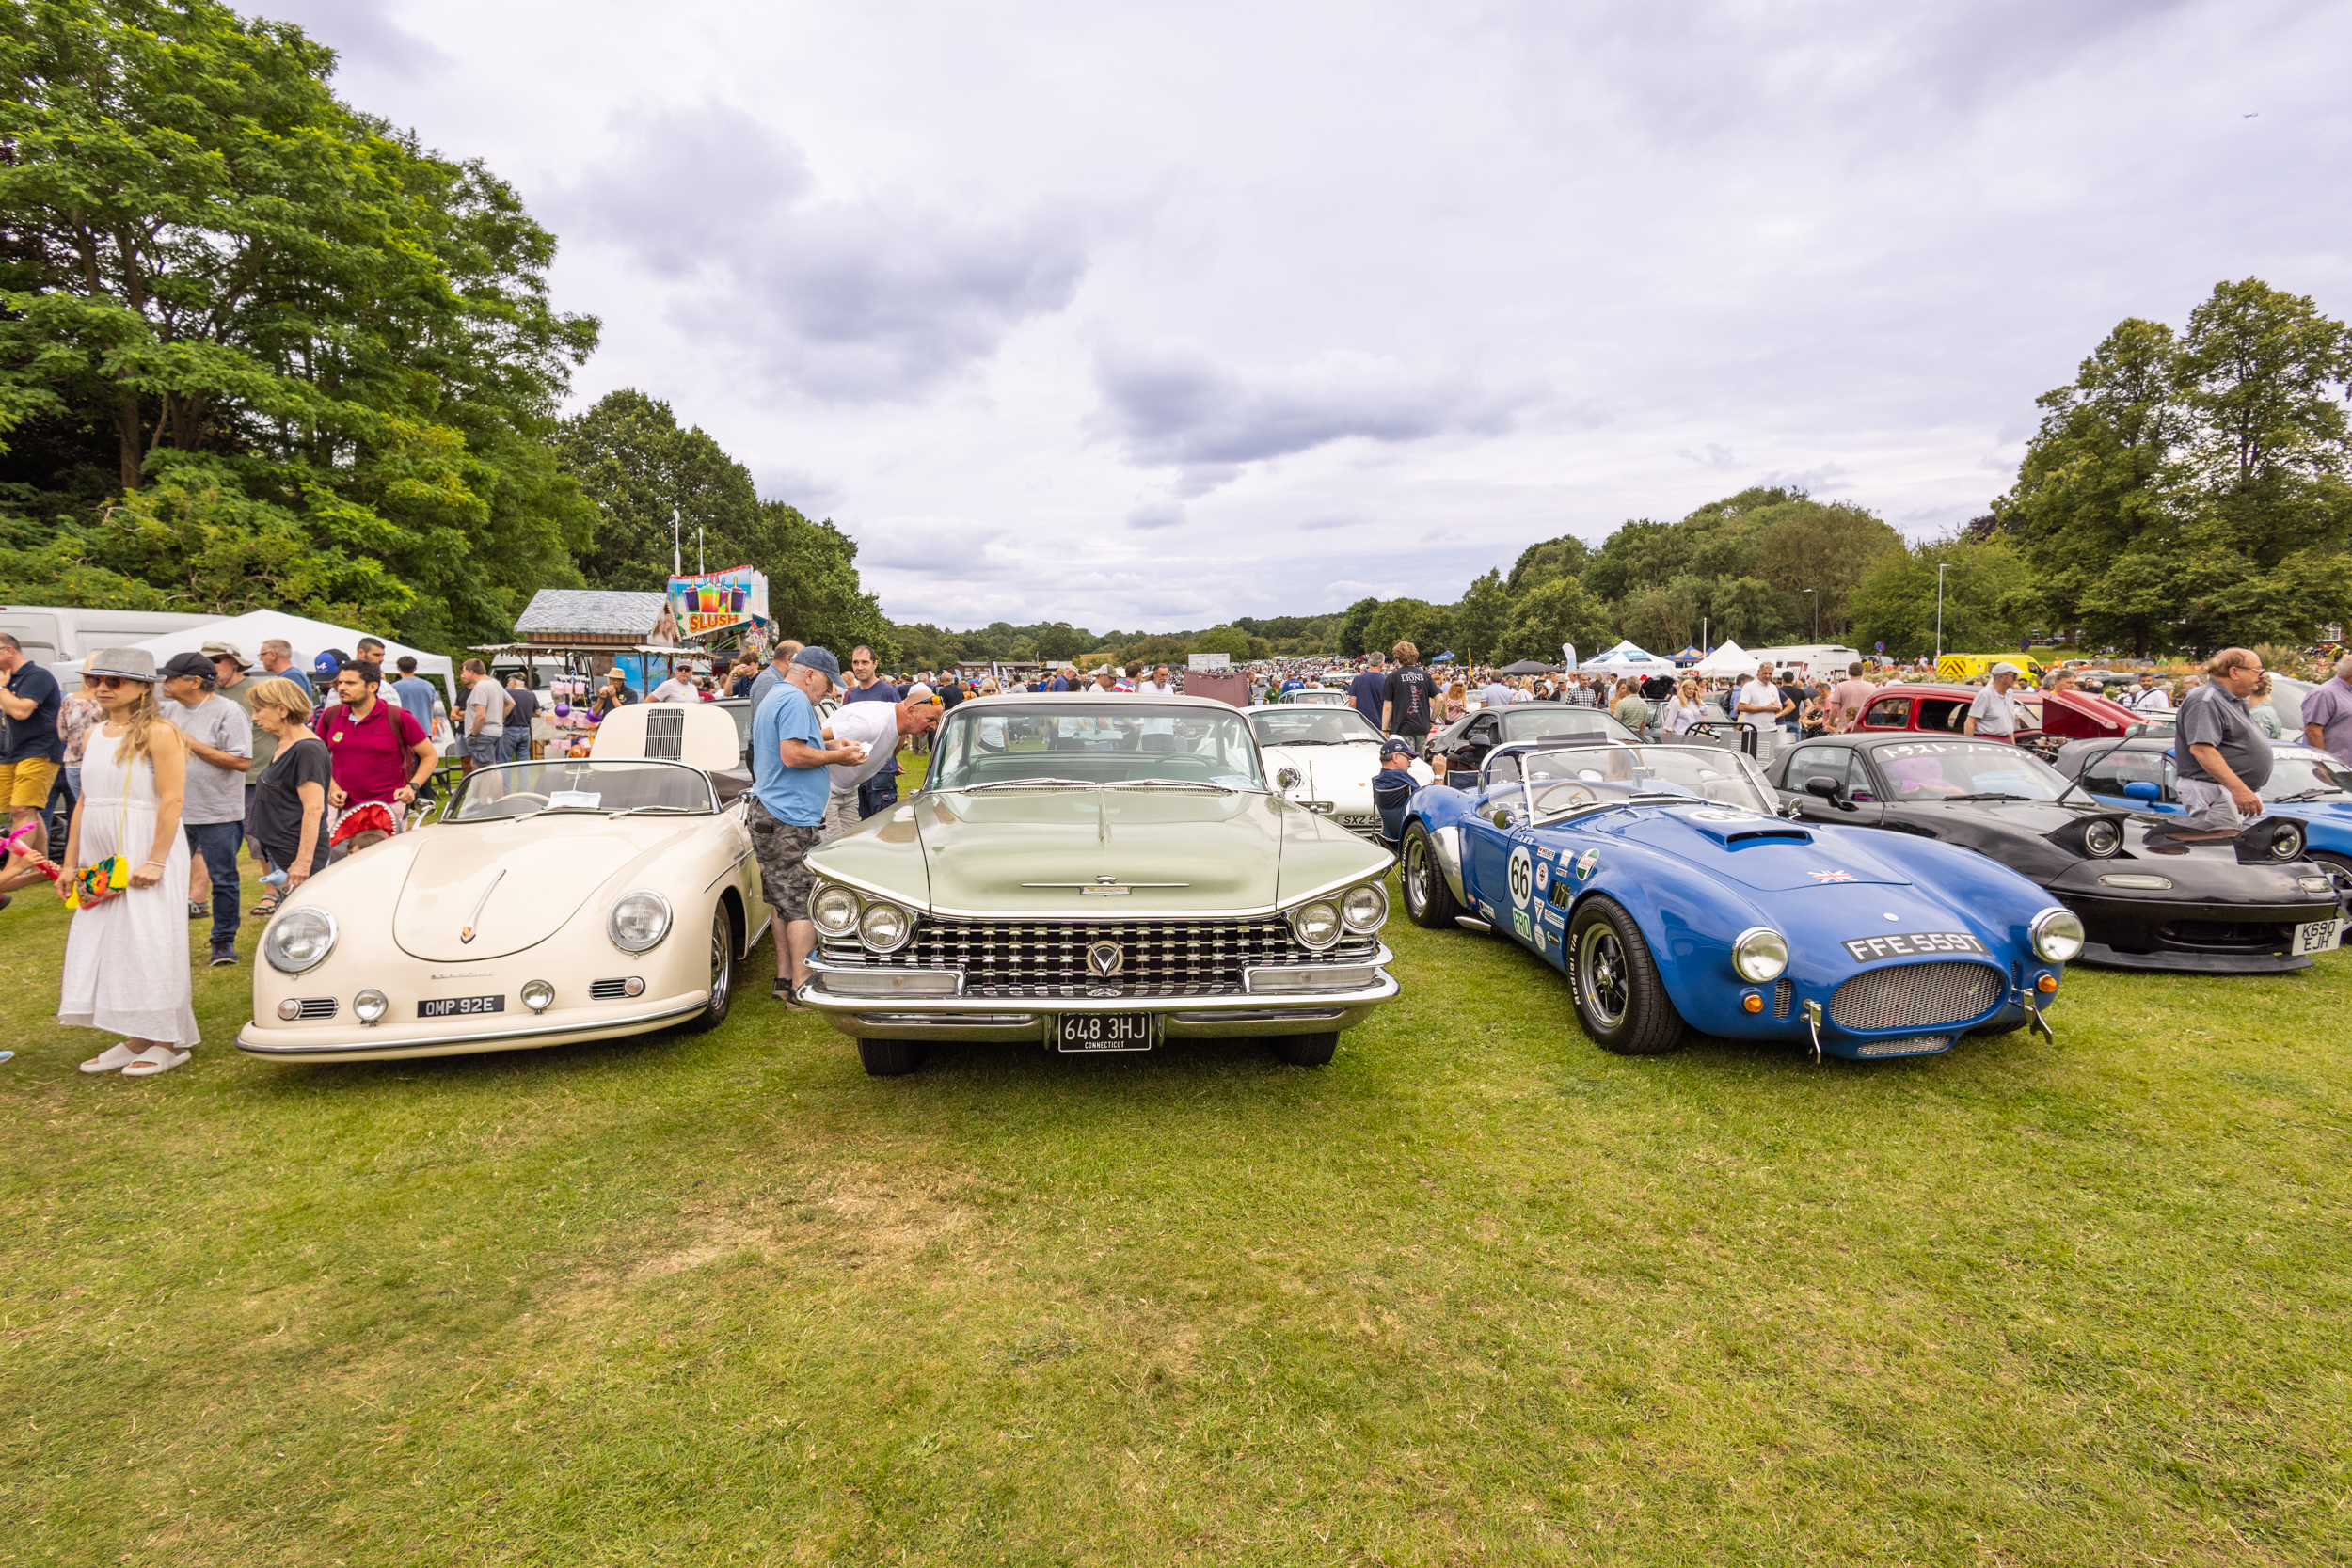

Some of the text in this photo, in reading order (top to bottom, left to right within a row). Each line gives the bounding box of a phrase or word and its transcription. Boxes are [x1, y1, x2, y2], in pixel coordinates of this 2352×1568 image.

[690, 614, 739, 632] SLUSH
[1401, 673, 1424, 682] LIONS
[1511, 855, 1530, 900] 66
[1514, 911, 1531, 939] PRO
[2302, 921, 2336, 938] K690
[1847, 934, 1984, 960] FFE 559T
[2304, 935, 2328, 951] EJH
[431, 971, 493, 979] PORSCHE
[1570, 957, 1581, 1005] Radial
[426, 997, 494, 1016] OMP 92E
[1065, 1017, 1145, 1039] 648 3HJ
